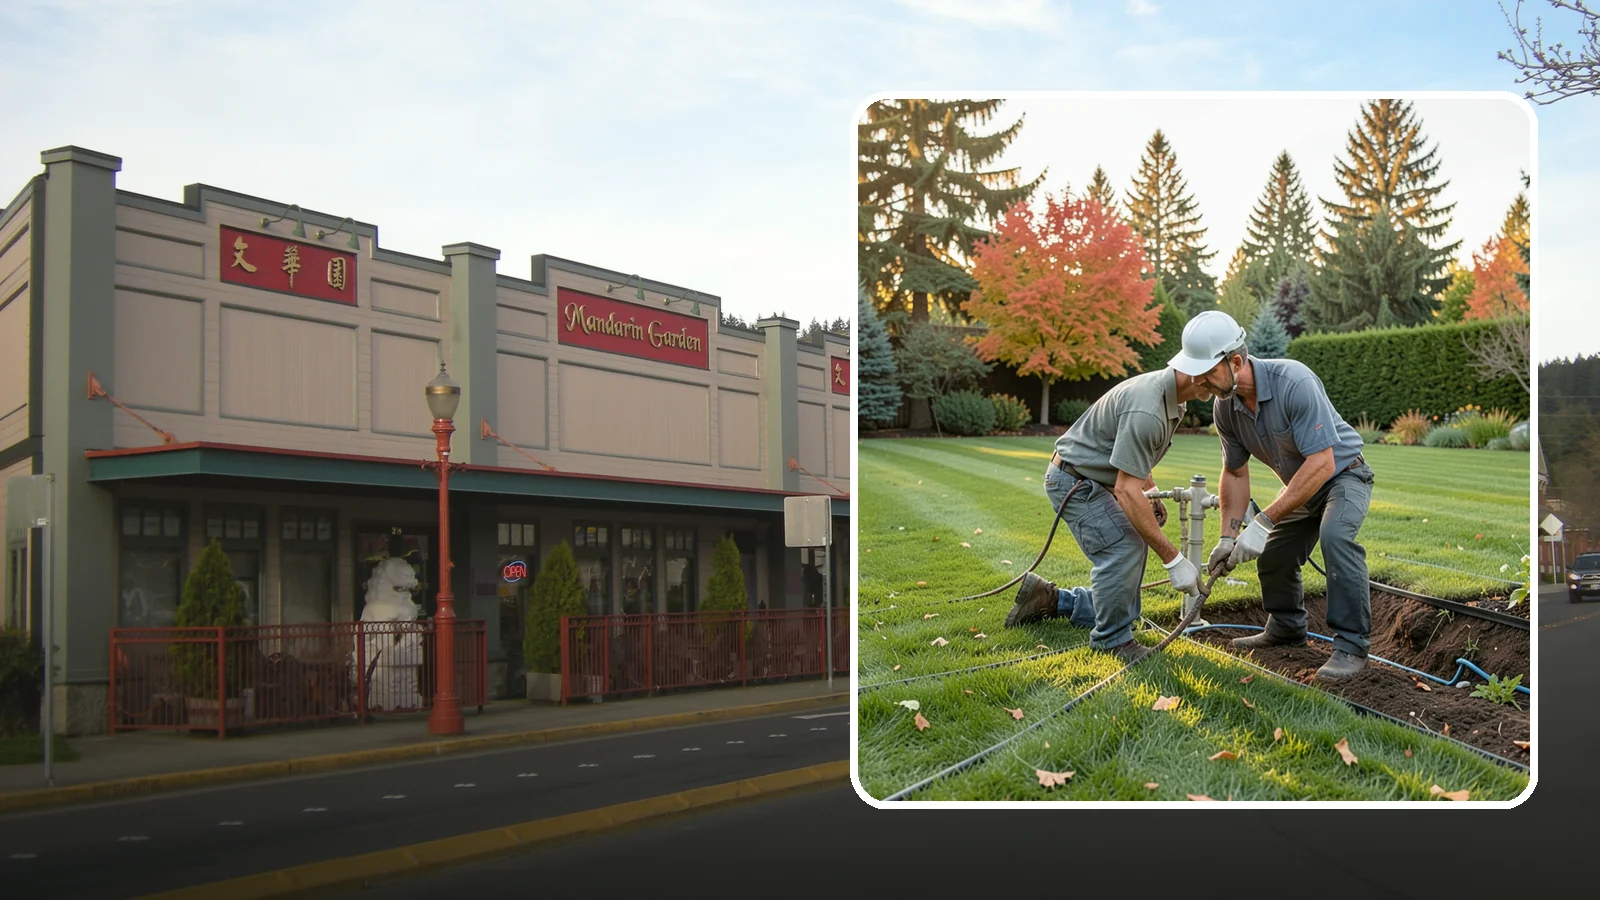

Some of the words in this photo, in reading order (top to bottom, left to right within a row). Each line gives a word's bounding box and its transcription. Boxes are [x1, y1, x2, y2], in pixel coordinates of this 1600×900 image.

[231, 236, 346, 291] 文華園
[564, 302, 644, 341] Mandarin
[648, 320, 701, 352] Garden
[503, 565, 527, 578] OPEN
